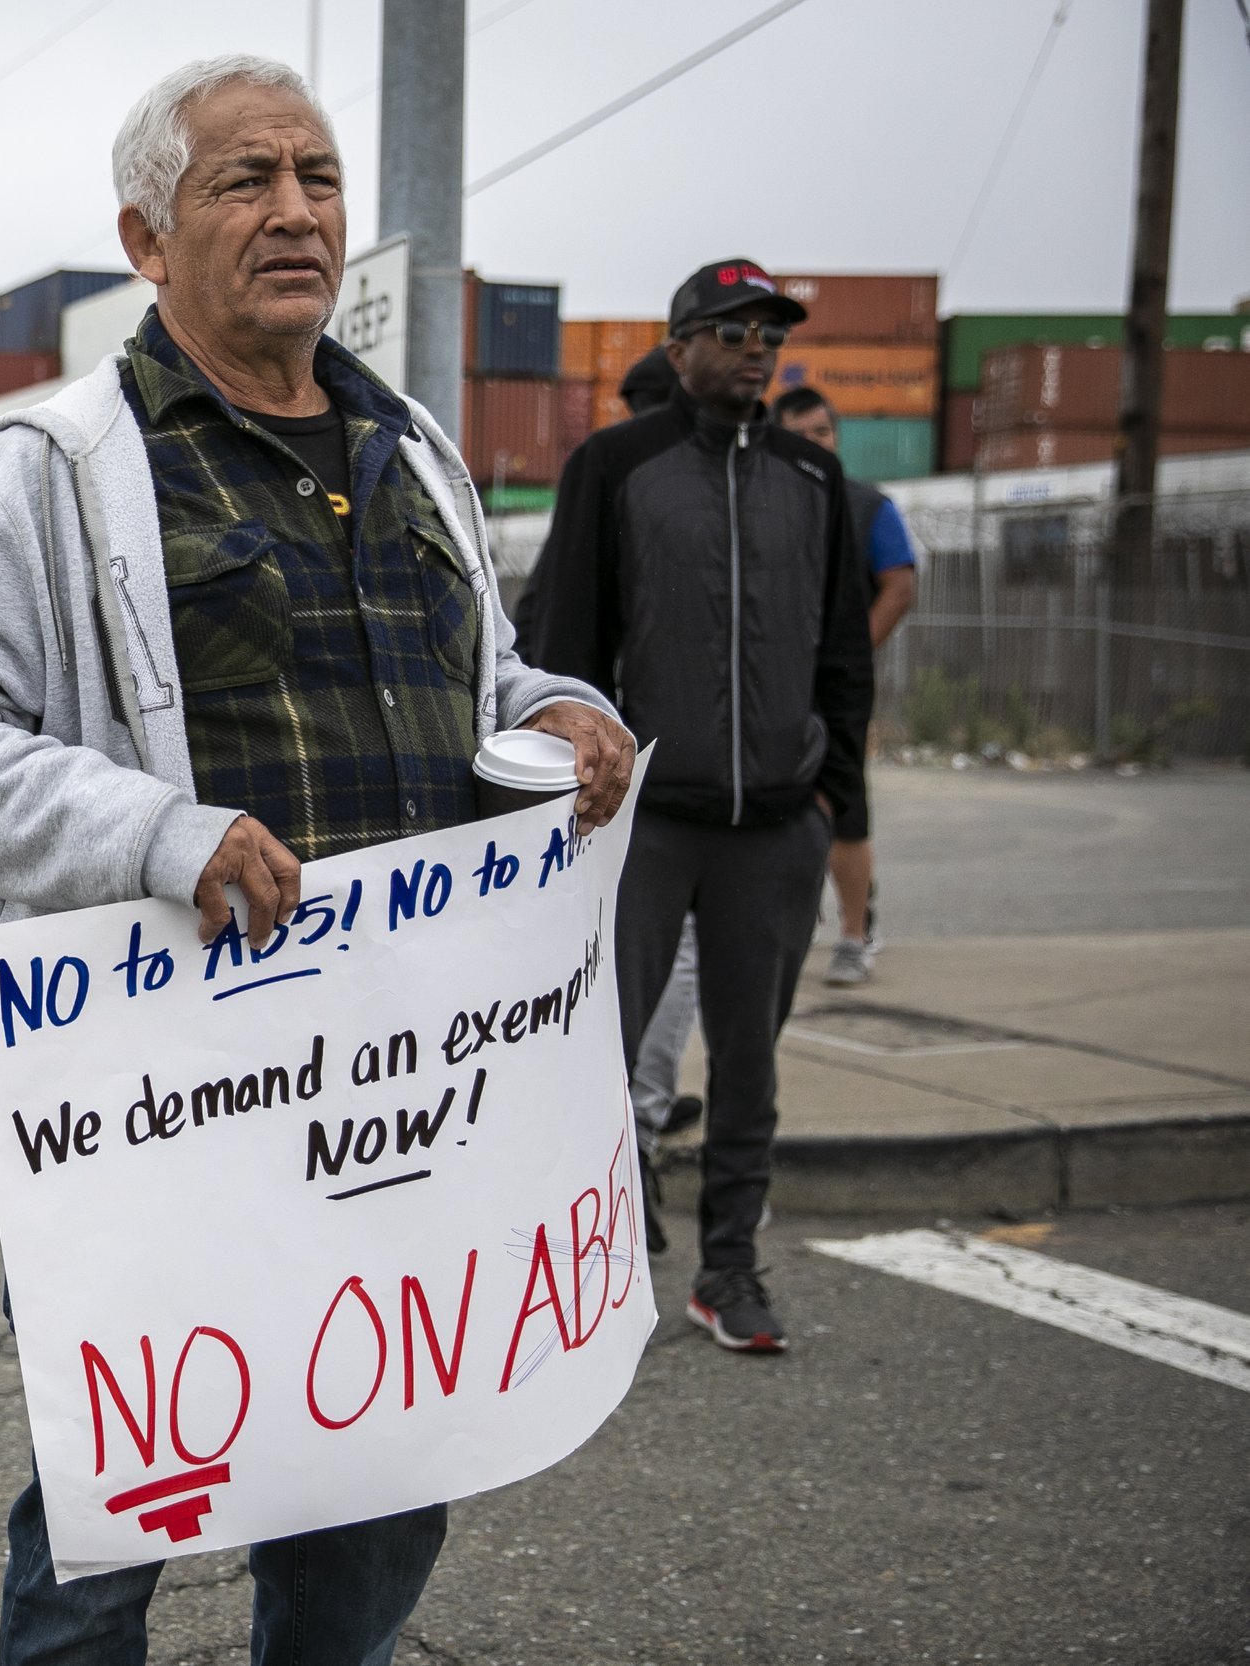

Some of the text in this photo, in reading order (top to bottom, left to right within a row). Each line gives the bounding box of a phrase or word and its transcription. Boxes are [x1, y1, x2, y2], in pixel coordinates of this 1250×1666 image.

[113, 921, 175, 998] to
[201, 879, 363, 981] AB5!
[388, 859, 453, 931] NO
[471, 840, 520, 897] to
[11, 1101, 102, 1175] We
[126, 1034, 324, 1146] demand
[351, 1029, 418, 1087] an
[305, 1068, 487, 1182] NOW!
[79, 1324, 251, 1477] NO
[306, 1249, 478, 1431] ON
